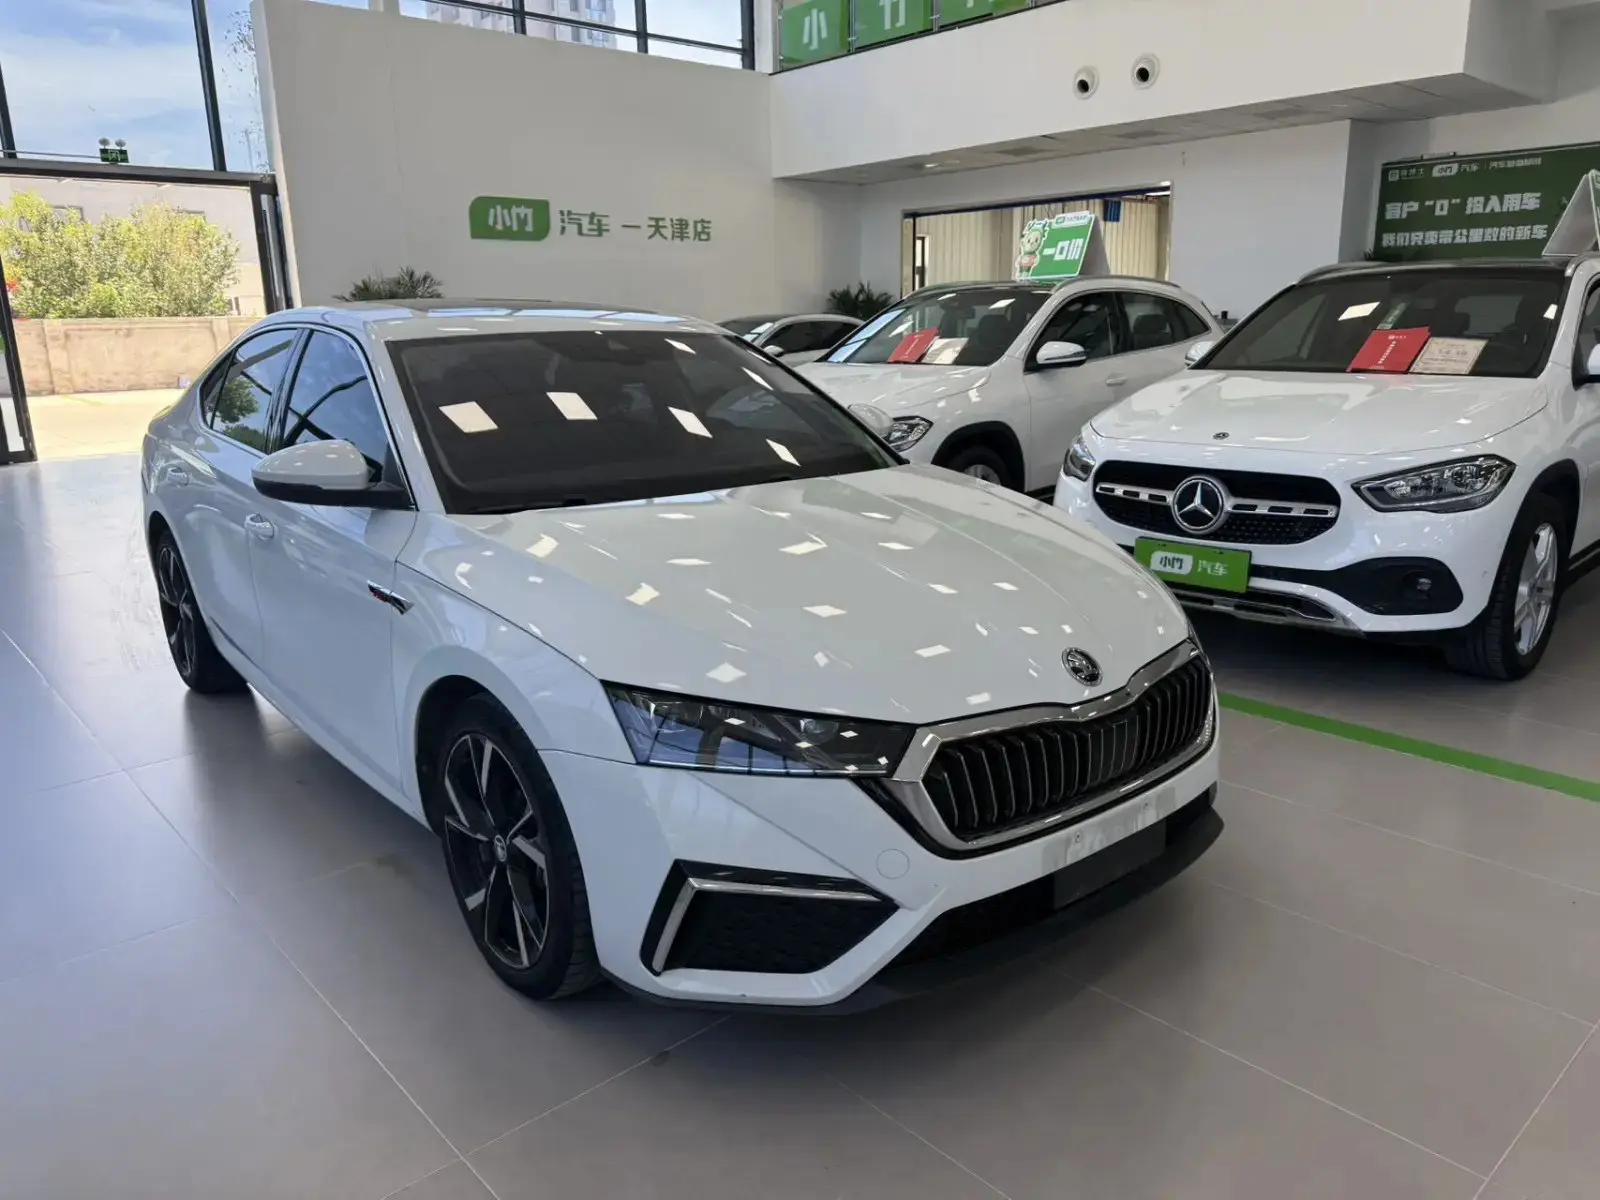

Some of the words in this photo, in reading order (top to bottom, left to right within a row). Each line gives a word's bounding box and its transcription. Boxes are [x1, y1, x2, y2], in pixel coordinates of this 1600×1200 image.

[488, 204, 534, 232] 小竹
[559, 209, 610, 237] 汽车
[647, 216, 712, 242] 天津店
[1159, 555, 1184, 571] 小竹
[1197, 559, 1228, 576] 汽车
